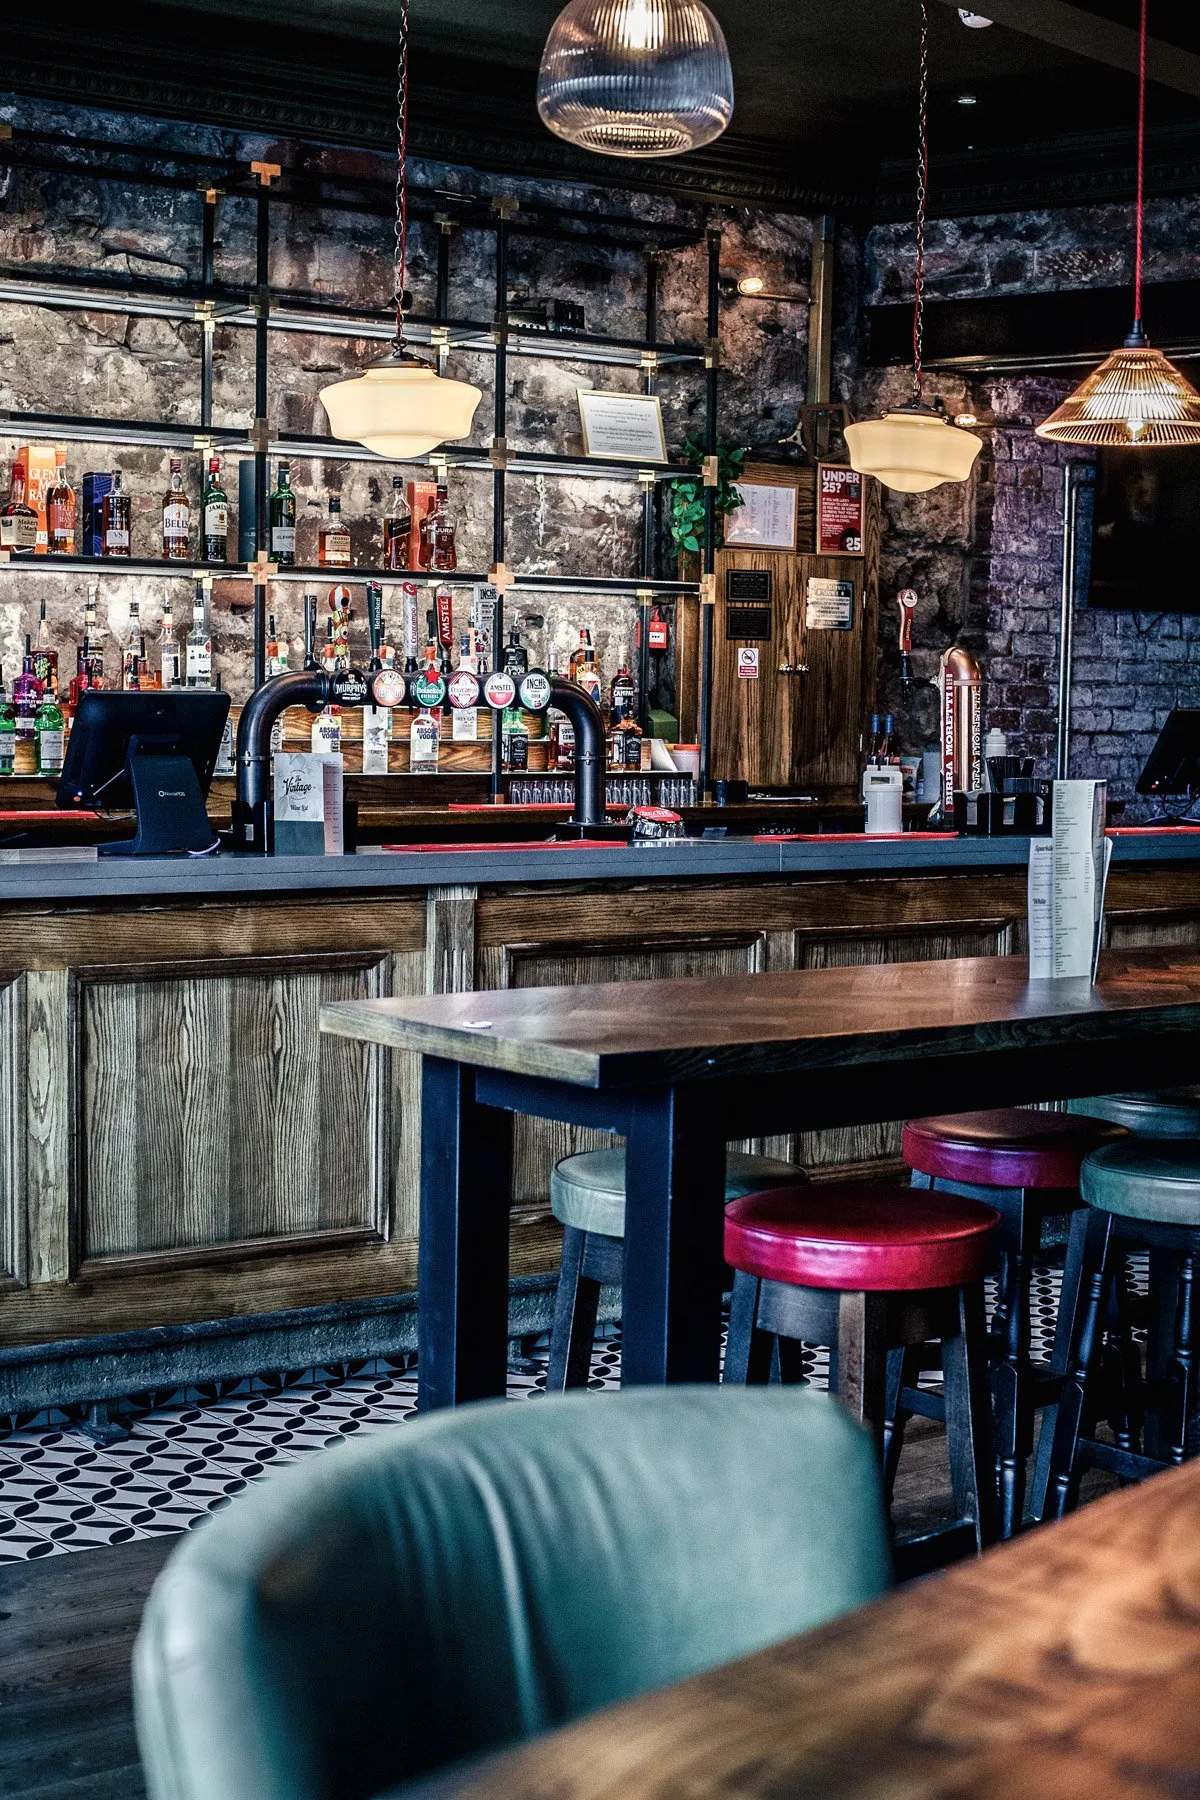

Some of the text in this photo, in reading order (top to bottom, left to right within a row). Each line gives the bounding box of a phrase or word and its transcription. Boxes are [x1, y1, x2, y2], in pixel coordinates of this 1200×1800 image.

[822, 470, 860, 484] UNDER
[822, 482, 842, 493] 25?
[38, 533, 46, 542] 12
[846, 536, 861, 551] 25
[442, 598, 450, 640] AMSTEL
[283, 776, 312, 795] Vintage
